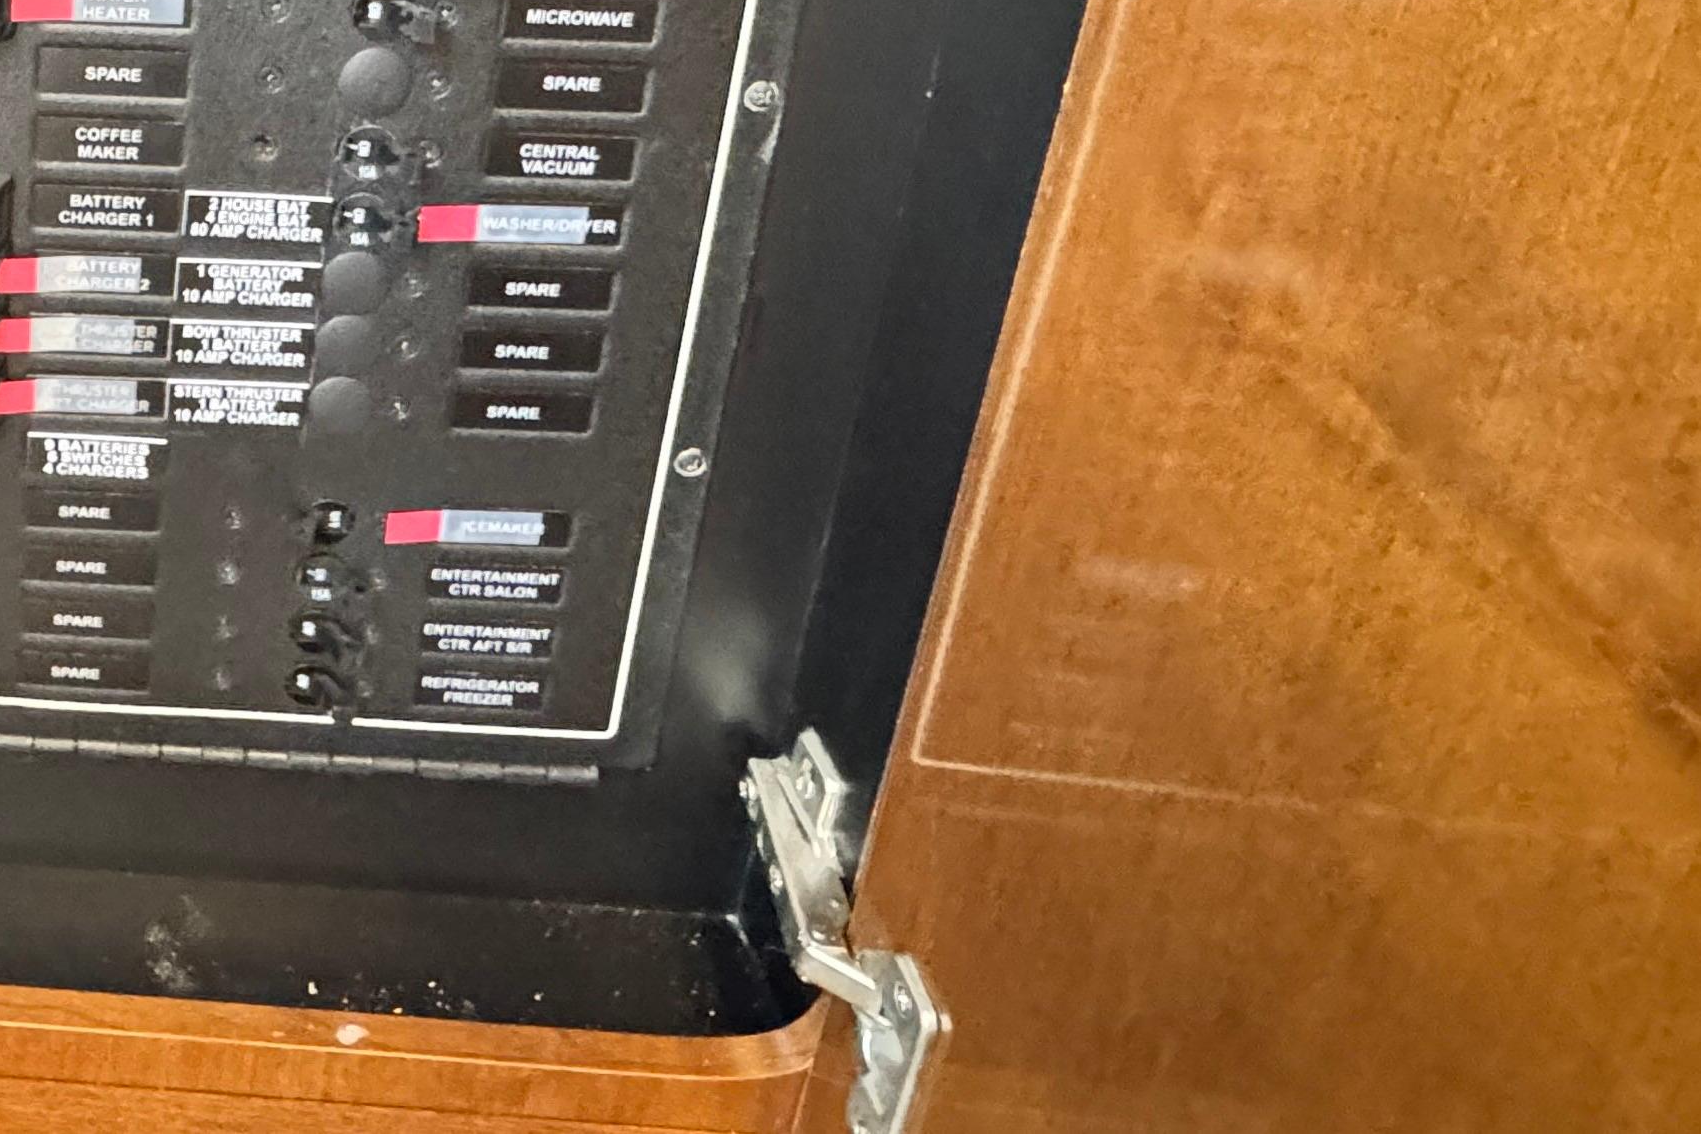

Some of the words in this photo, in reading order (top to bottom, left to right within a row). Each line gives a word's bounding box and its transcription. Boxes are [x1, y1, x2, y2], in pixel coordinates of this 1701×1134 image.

[82, 7, 150, 20] HEATER
[526, 8, 635, 28] MICROWAVE
[85, 66, 142, 82] SPARE
[542, 75, 602, 92] SPARE
[75, 127, 143, 143] COFFEE
[78, 145, 139, 160] MAKER
[519, 143, 601, 161] CENTRAL
[521, 159, 597, 176] VACUUM
[69, 194, 146, 210] BATTERY
[221, 198, 275, 213] HOUSE
[277, 200, 310, 215] BAT
[58, 210, 141, 226] CHARGER
[145, 213, 154, 227] 1
[218, 211, 275, 226] ENGINE
[278, 214, 311, 228] BAT
[481, 216, 617, 235] WASHER/DRYER
[210, 224, 245, 238] AMP
[247, 226, 323, 243] CHARGER
[66, 259, 140, 274] BATTERY
[197, 264, 205, 278] 1
[208, 264, 304, 282] GENERATOR
[140, 278, 151, 291] 2
[213, 277, 284, 292] BATTERY
[504, 281, 561, 298] SPARE
[202, 290, 236, 304] AMP
[237, 291, 314, 307] CHARGER
[222, 326, 303, 343] THRUSTER
[212, 338, 282, 352] BATTERY
[494, 344, 549, 360] SPARE
[230, 351, 305, 368] CHARGER
[225, 386, 303, 403] THRUSTER
[209, 398, 277, 412] BATTERY
[486, 405, 541, 421] SPARE
[227, 412, 300, 427] CHARGER
[58, 439, 150, 456] BATTERIES
[60, 451, 146, 467] SWITCHES
[56, 463, 149, 479] CHARGERS
[58, 505, 111, 520] SPARE
[56, 560, 107, 575] SPARE
[430, 568, 561, 586] ENTERTAINMENT
[448, 583, 481, 597] CTR
[483, 584, 538, 599] SALON
[52, 613, 104, 628] SPARE
[423, 623, 551, 641] ENTERTAINMENT
[437, 638, 471, 651] CTR
[472, 640, 503, 653] AFT
[50, 665, 100, 680] SPARE
[421, 676, 540, 694] REFRIGERATOR
[442, 691, 514, 707] FREEZER
